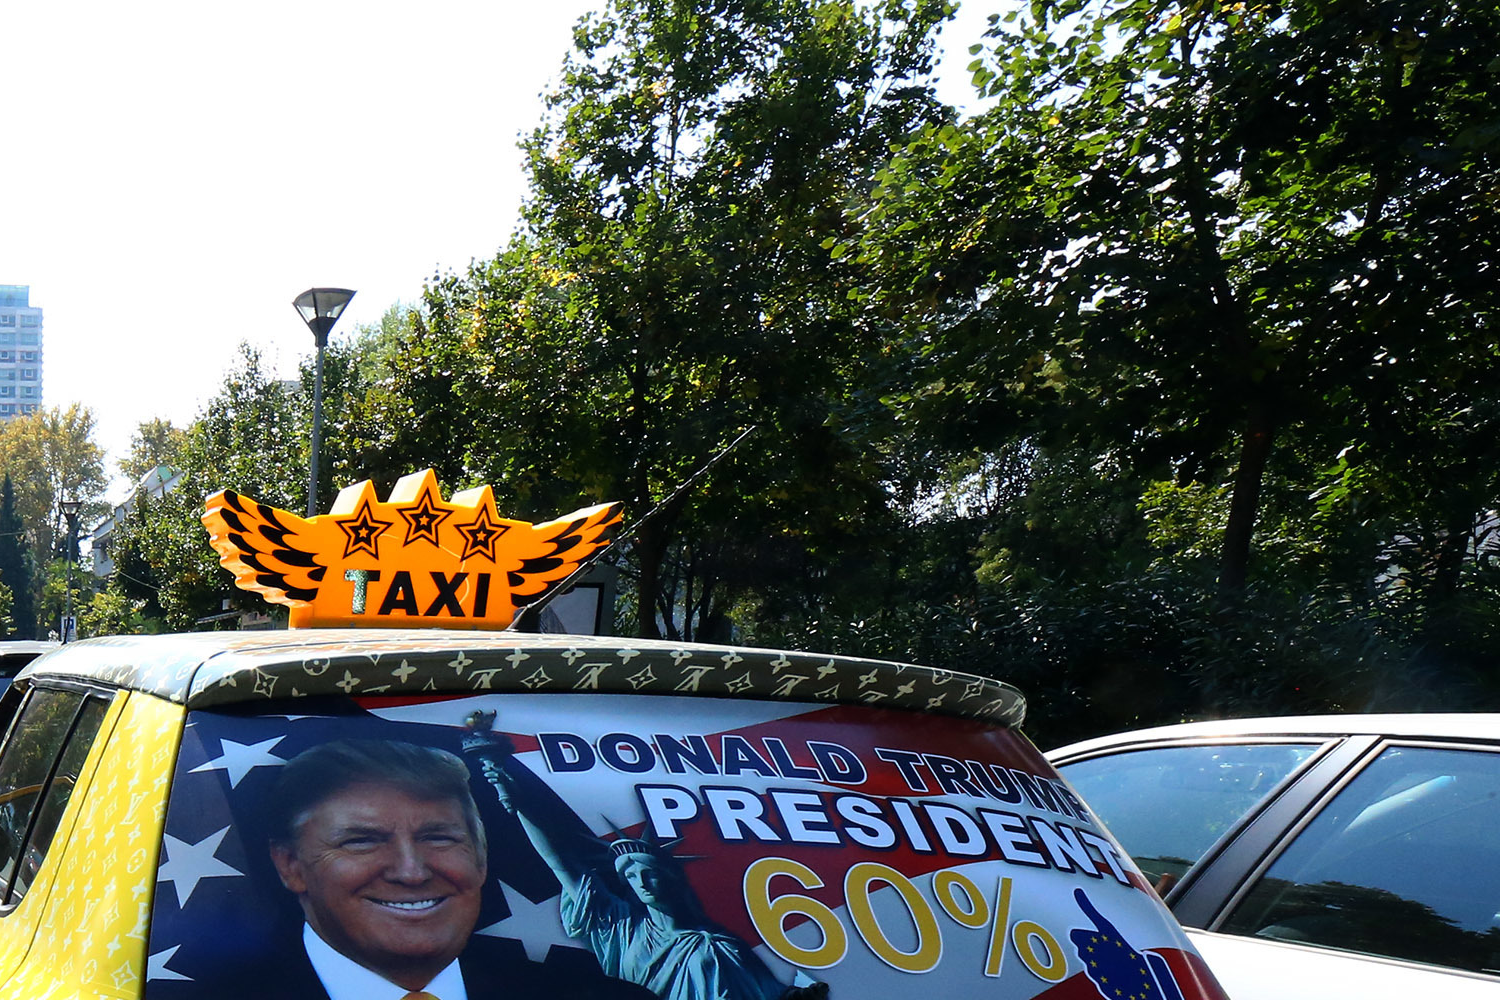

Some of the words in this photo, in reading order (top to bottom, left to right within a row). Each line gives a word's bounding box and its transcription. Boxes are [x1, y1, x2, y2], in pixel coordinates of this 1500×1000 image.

[344, 568, 492, 618] TAXI
[536, 730, 868, 785] DONALD
[878, 746, 1094, 825] TRUMP
[636, 783, 1134, 886] PRESIDENT
[744, 857, 1069, 984] 60%
